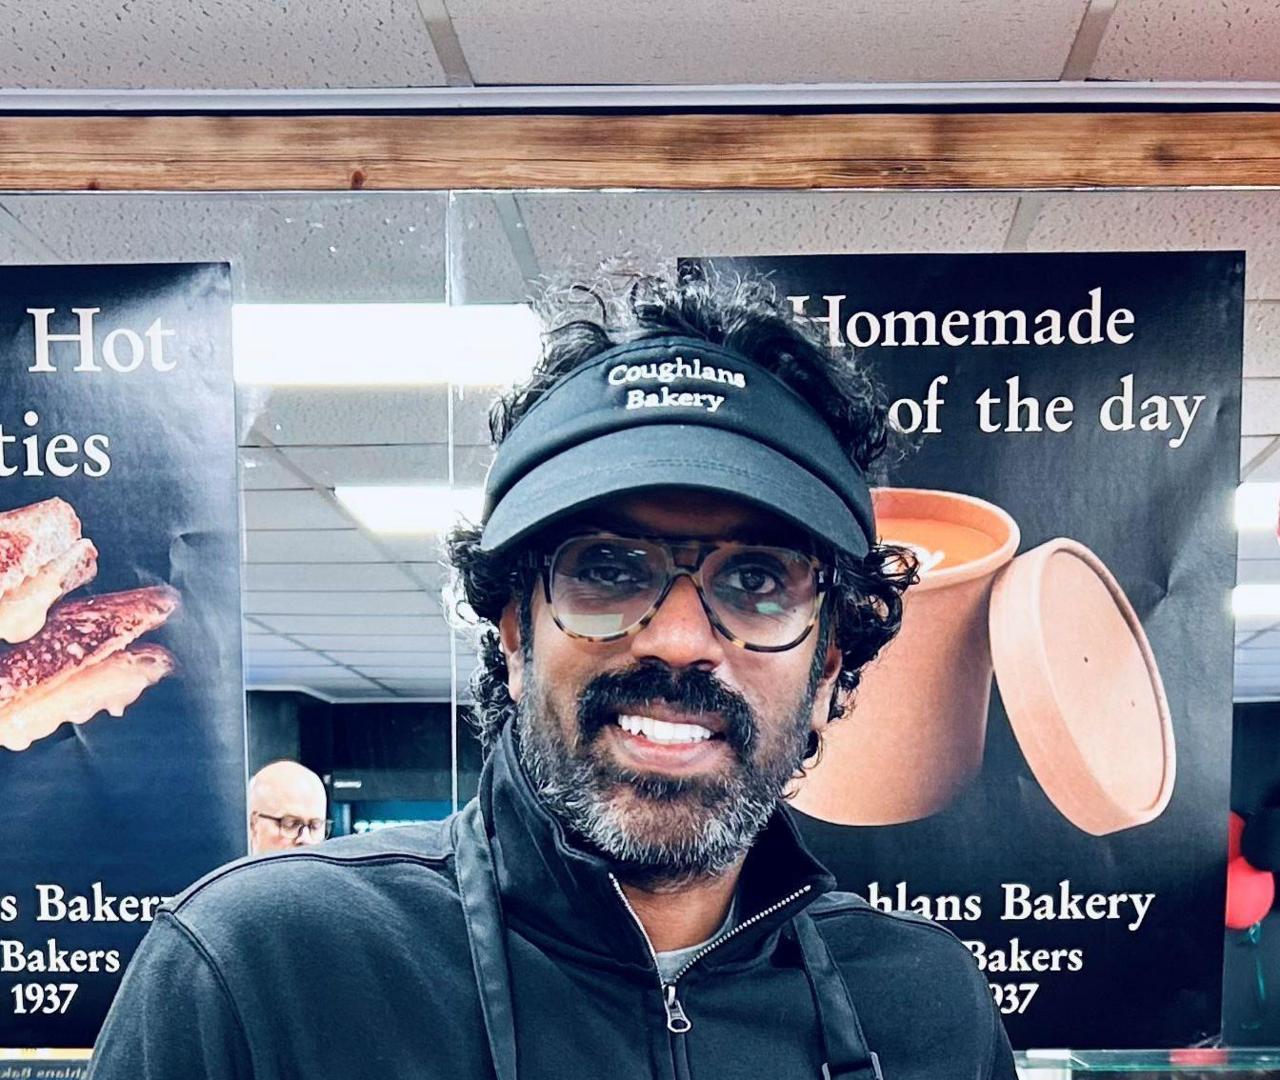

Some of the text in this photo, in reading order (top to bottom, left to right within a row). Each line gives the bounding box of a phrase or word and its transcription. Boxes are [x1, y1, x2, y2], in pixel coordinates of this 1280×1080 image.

[786, 286, 1136, 350] Homemade
[25, 305, 178, 374] Hot
[608, 357, 746, 389] Coughlans
[625, 386, 725, 412] Bakery
[888, 372, 1206, 449] of the day
[35, 883, 175, 923] Baker
[868, 880, 1156, 931] hlans Bakery
[0, 938, 122, 974] Bakers
[961, 937, 1084, 973] Bakers
[11, 983, 79, 1015] 1937
